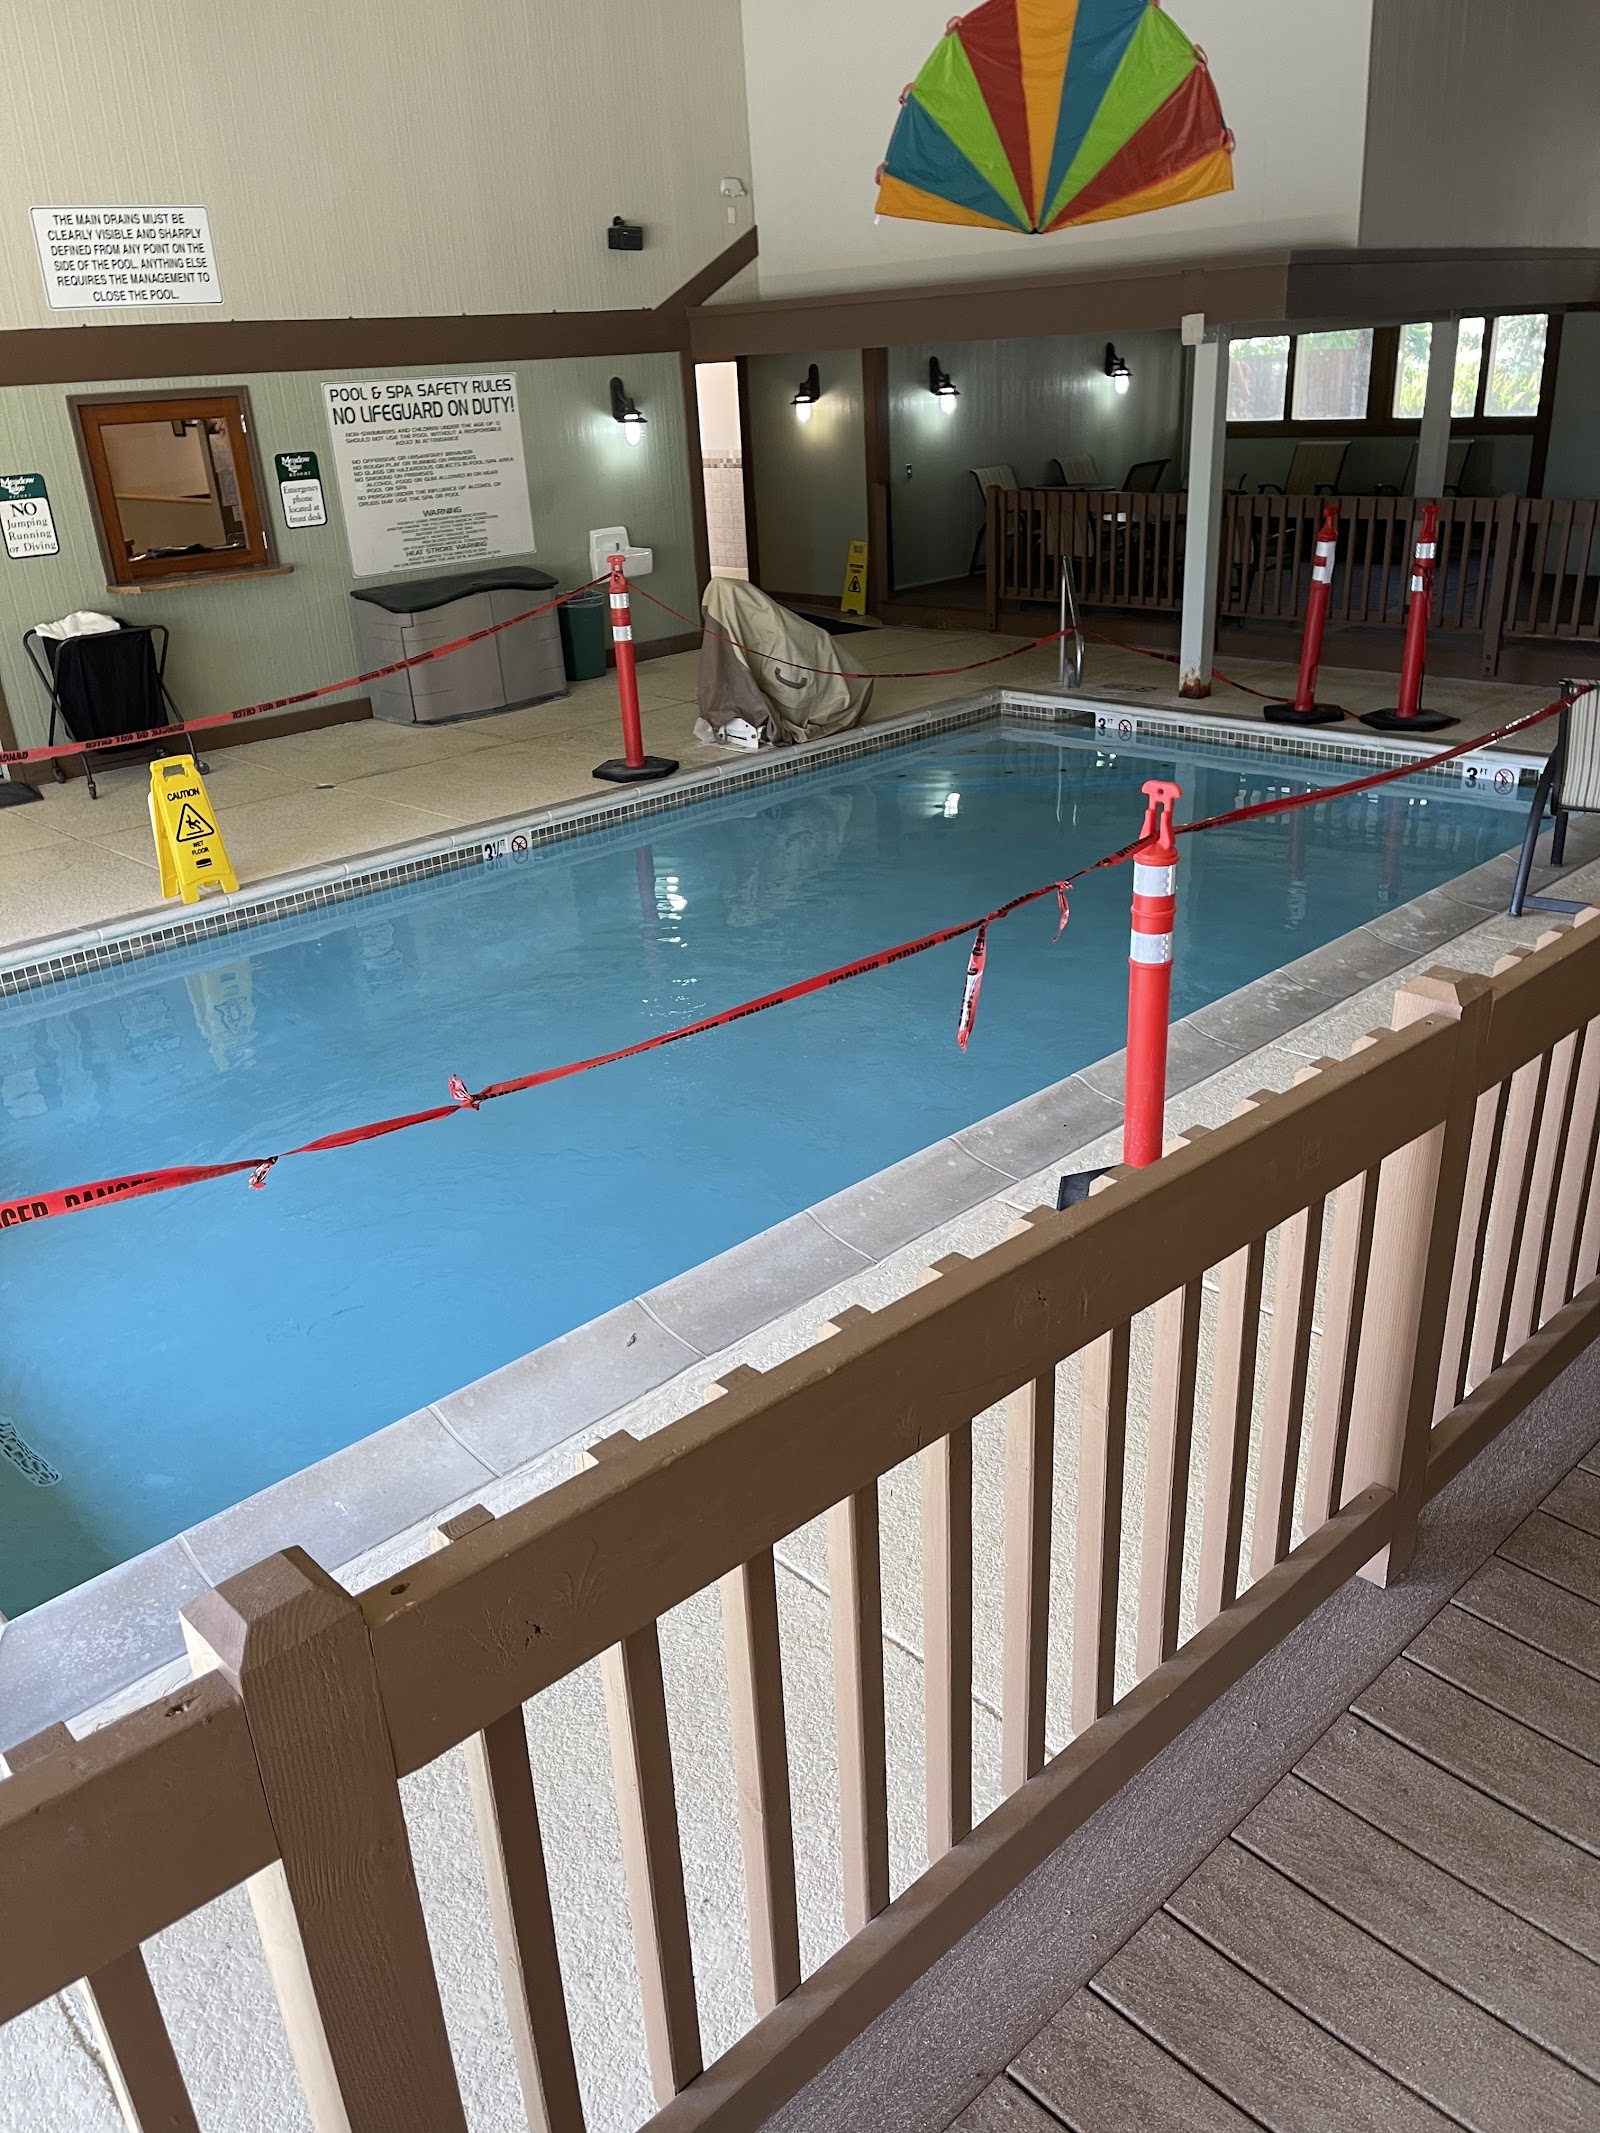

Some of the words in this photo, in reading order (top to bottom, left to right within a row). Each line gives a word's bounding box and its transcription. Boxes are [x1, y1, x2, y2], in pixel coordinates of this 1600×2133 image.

[52, 214, 74, 225] THE
[76, 214, 101, 224] MAIN
[103, 213, 140, 224] DRAINS
[143, 213, 168, 224] MUST
[172, 213, 185, 224] BE
[47, 229, 92, 241] CLEARLY
[95, 229, 133, 239] VISIBLE
[137, 228, 156, 239] AND
[159, 228, 201, 239] SHARPLY
[51, 245, 91, 256] DEFINED
[94, 244, 120, 255] FROM
[123, 244, 140, 254] ANY
[143, 243, 169, 253] POINT
[172, 243, 186, 253] ON
[187, 243, 205, 253] THE
[54, 260, 75, 271] SIDE
[77, 260, 89, 270] OF
[91, 259, 110, 270] THE
[141, 258, 184, 269] ANYTHING
[186, 257, 208, 268] ELSE
[57, 274, 107, 286] REQUIRES
[108, 274, 129, 284] THE
[130, 272, 195, 284] MANAGEMENT
[197, 272, 210, 282] TO
[93, 291, 127, 302] CLOSE
[128, 290, 148, 300] THE
[329, 387, 368, 402] POOL
[371, 386, 382, 399] &
[386, 384, 414, 399] SPA
[417, 381, 468, 397] SAFETY
[472, 379, 511, 393] RULES
[332, 406, 356, 425] NO
[360, 401, 443, 423] LIFEGUARD
[447, 399, 469, 416] ON
[472, 396, 515, 415] DUTY!
[282, 485, 318, 494] Emergency
[292, 495, 313, 505] phone
[9, 502, 37, 517] NO
[288, 503, 312, 513] located
[7, 518, 48, 530] Jumping
[8, 530, 52, 541] Running
[23, 540, 56, 552] Diving
[1466, 766, 1478, 780] 3
[1480, 767, 1488, 775] FT
[167, 787, 200, 801] CAUTION
[193, 840, 204, 848] WET
[192, 846, 210, 856] FLOOR
